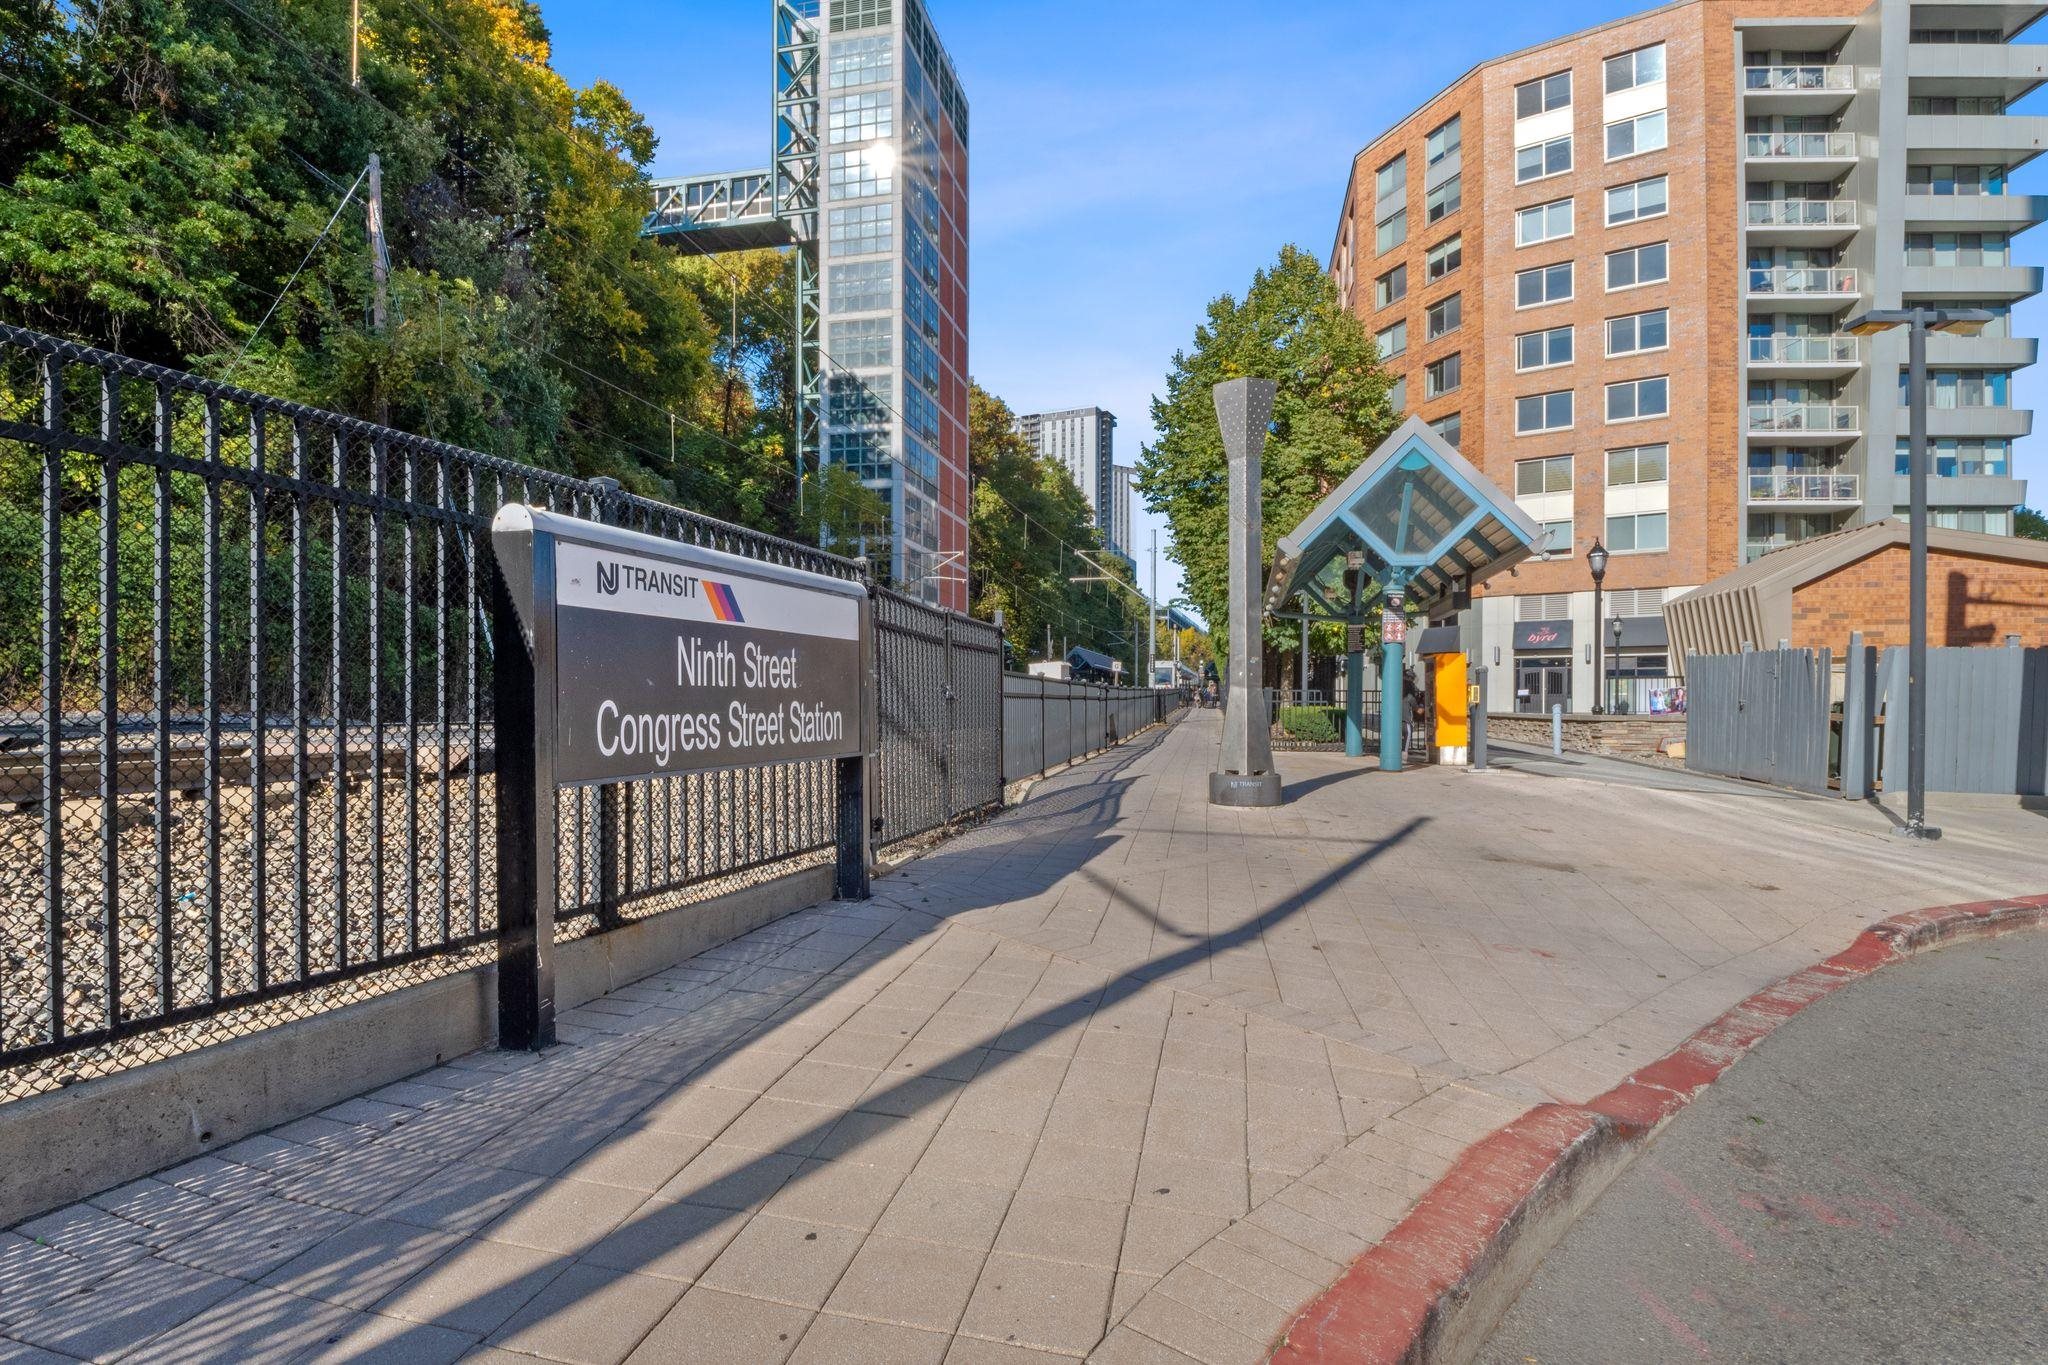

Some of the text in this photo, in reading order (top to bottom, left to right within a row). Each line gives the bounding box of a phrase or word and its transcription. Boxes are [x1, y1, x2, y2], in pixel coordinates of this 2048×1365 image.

[597, 561, 699, 598] NJ TRANSIT
[1527, 632, 1558, 644] byrd
[677, 635, 797, 688] Ninth Street
[596, 700, 843, 767] Congress Street Station
